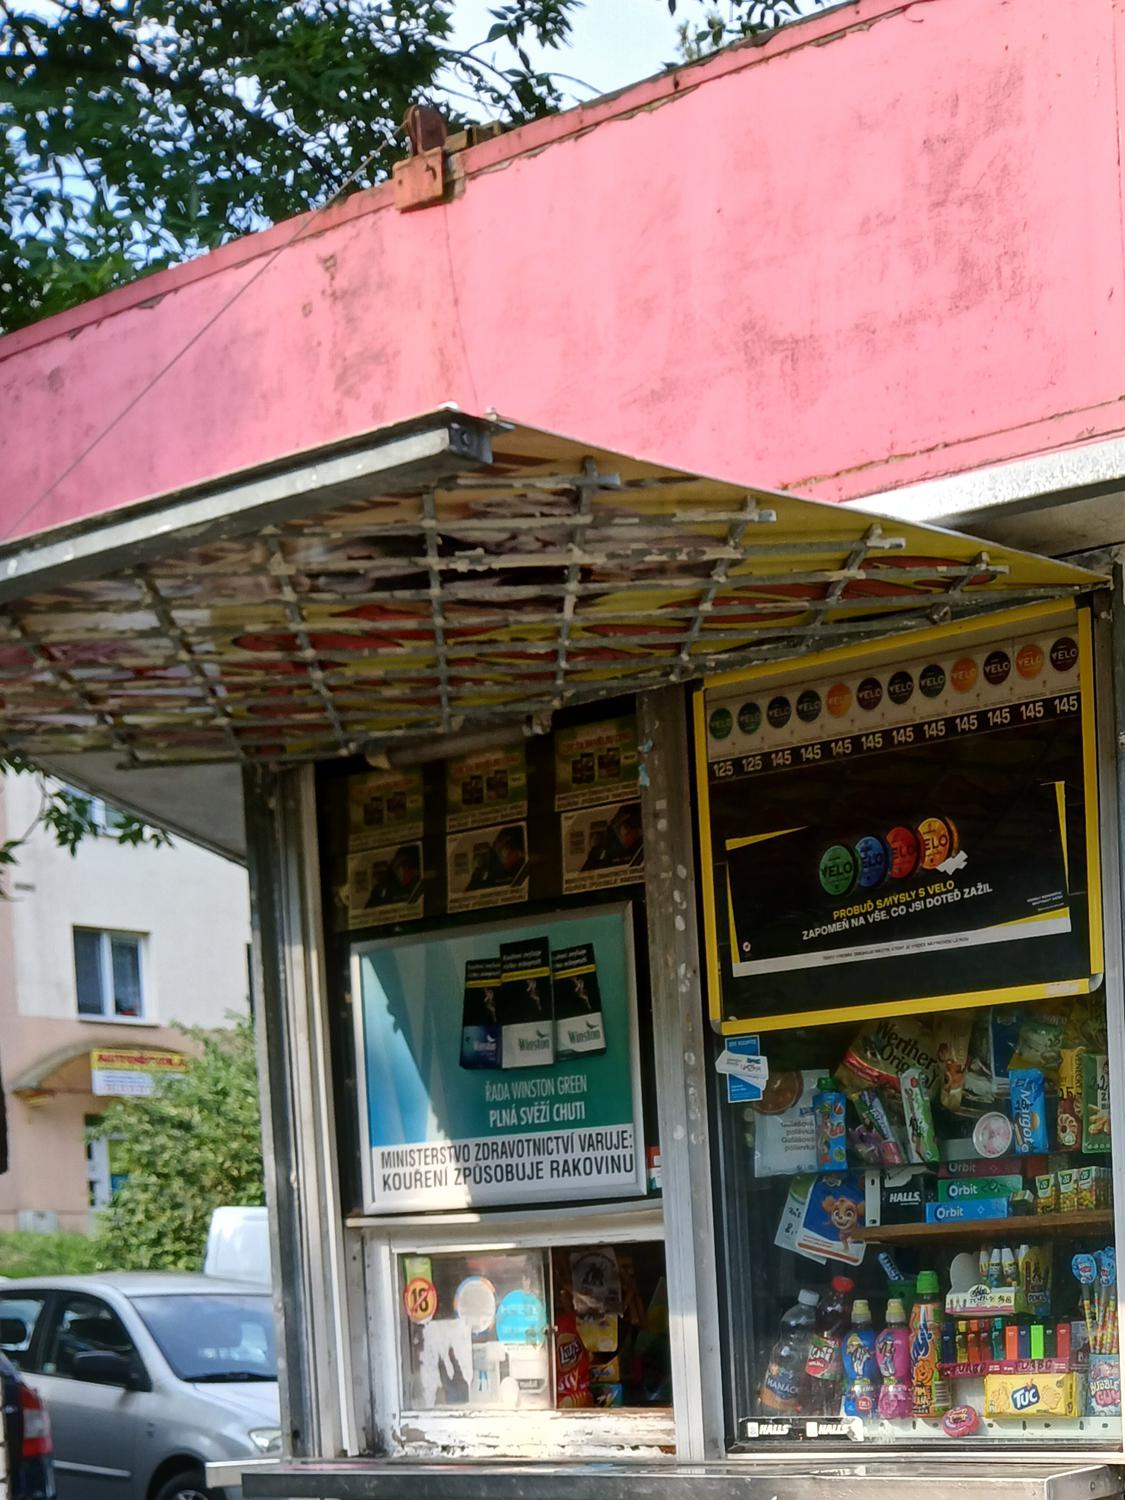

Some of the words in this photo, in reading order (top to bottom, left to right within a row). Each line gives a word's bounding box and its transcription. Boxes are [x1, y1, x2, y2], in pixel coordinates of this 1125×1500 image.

[890, 683, 913, 692] VELO
[921, 675, 944, 685] VELO
[985, 661, 1010, 672] VELO
[1052, 649, 1077, 660] VELO
[714, 762, 733, 776] 125
[742, 757, 762, 771] 125
[771, 751, 791, 766] 145
[801, 745, 821, 761] 145
[831, 740, 851, 755] 145
[861, 733, 883, 749] 145
[892, 727, 914, 744] 145
[924, 721, 945, 738] 145
[955, 715, 978, 732] 145
[988, 709, 1010, 726] 145
[1020, 702, 1043, 719] 145
[1054, 695, 1078, 713] 145
[820, 863, 852, 880] VELO
[801, 917, 849, 940] ZAPOMEŇ
[851, 913, 865, 927] NA
[890, 905, 907, 917] CO
[908, 899, 925, 913] JSI
[926, 890, 962, 908] DOTEĎ
[963, 881, 993, 899] ZAŽIL
[833, 900, 875, 920] PROBUĎ
[875, 889, 917, 908] SMYSLY
[918, 886, 926, 897] S
[927, 880, 955, 895] VELO
[518, 1037, 550, 1051] Winston
[568, 1028, 601, 1044] Winston
[485, 1079, 510, 1102] ŘADA
[511, 1076, 555, 1100] WINSTON
[557, 1073, 587, 1095] GREEN
[489, 1103, 518, 1128] PLNÁ
[520, 1100, 551, 1124] SVĚŽÍ
[552, 1100, 585, 1122] CHUTI
[380, 1143, 471, 1170] MINISTERSTVO
[474, 1133, 575, 1161] ZDRAVOTNICTVÍ
[579, 1129, 634, 1153] VARUJE:
[382, 1168, 449, 1192] KOUŘENÍ
[453, 1162, 545, 1187] ZPŮSOBUJE
[550, 1153, 634, 1180] RAKOVINU
[948, 1161, 976, 1174] Orbit
[889, 1191, 921, 1203] HALLS
[948, 1183, 978, 1197] Orbit
[936, 1206, 964, 1220] Orbit
[1013, 1388, 1039, 1410] TUC
[759, 1423, 790, 1435] HALLS
